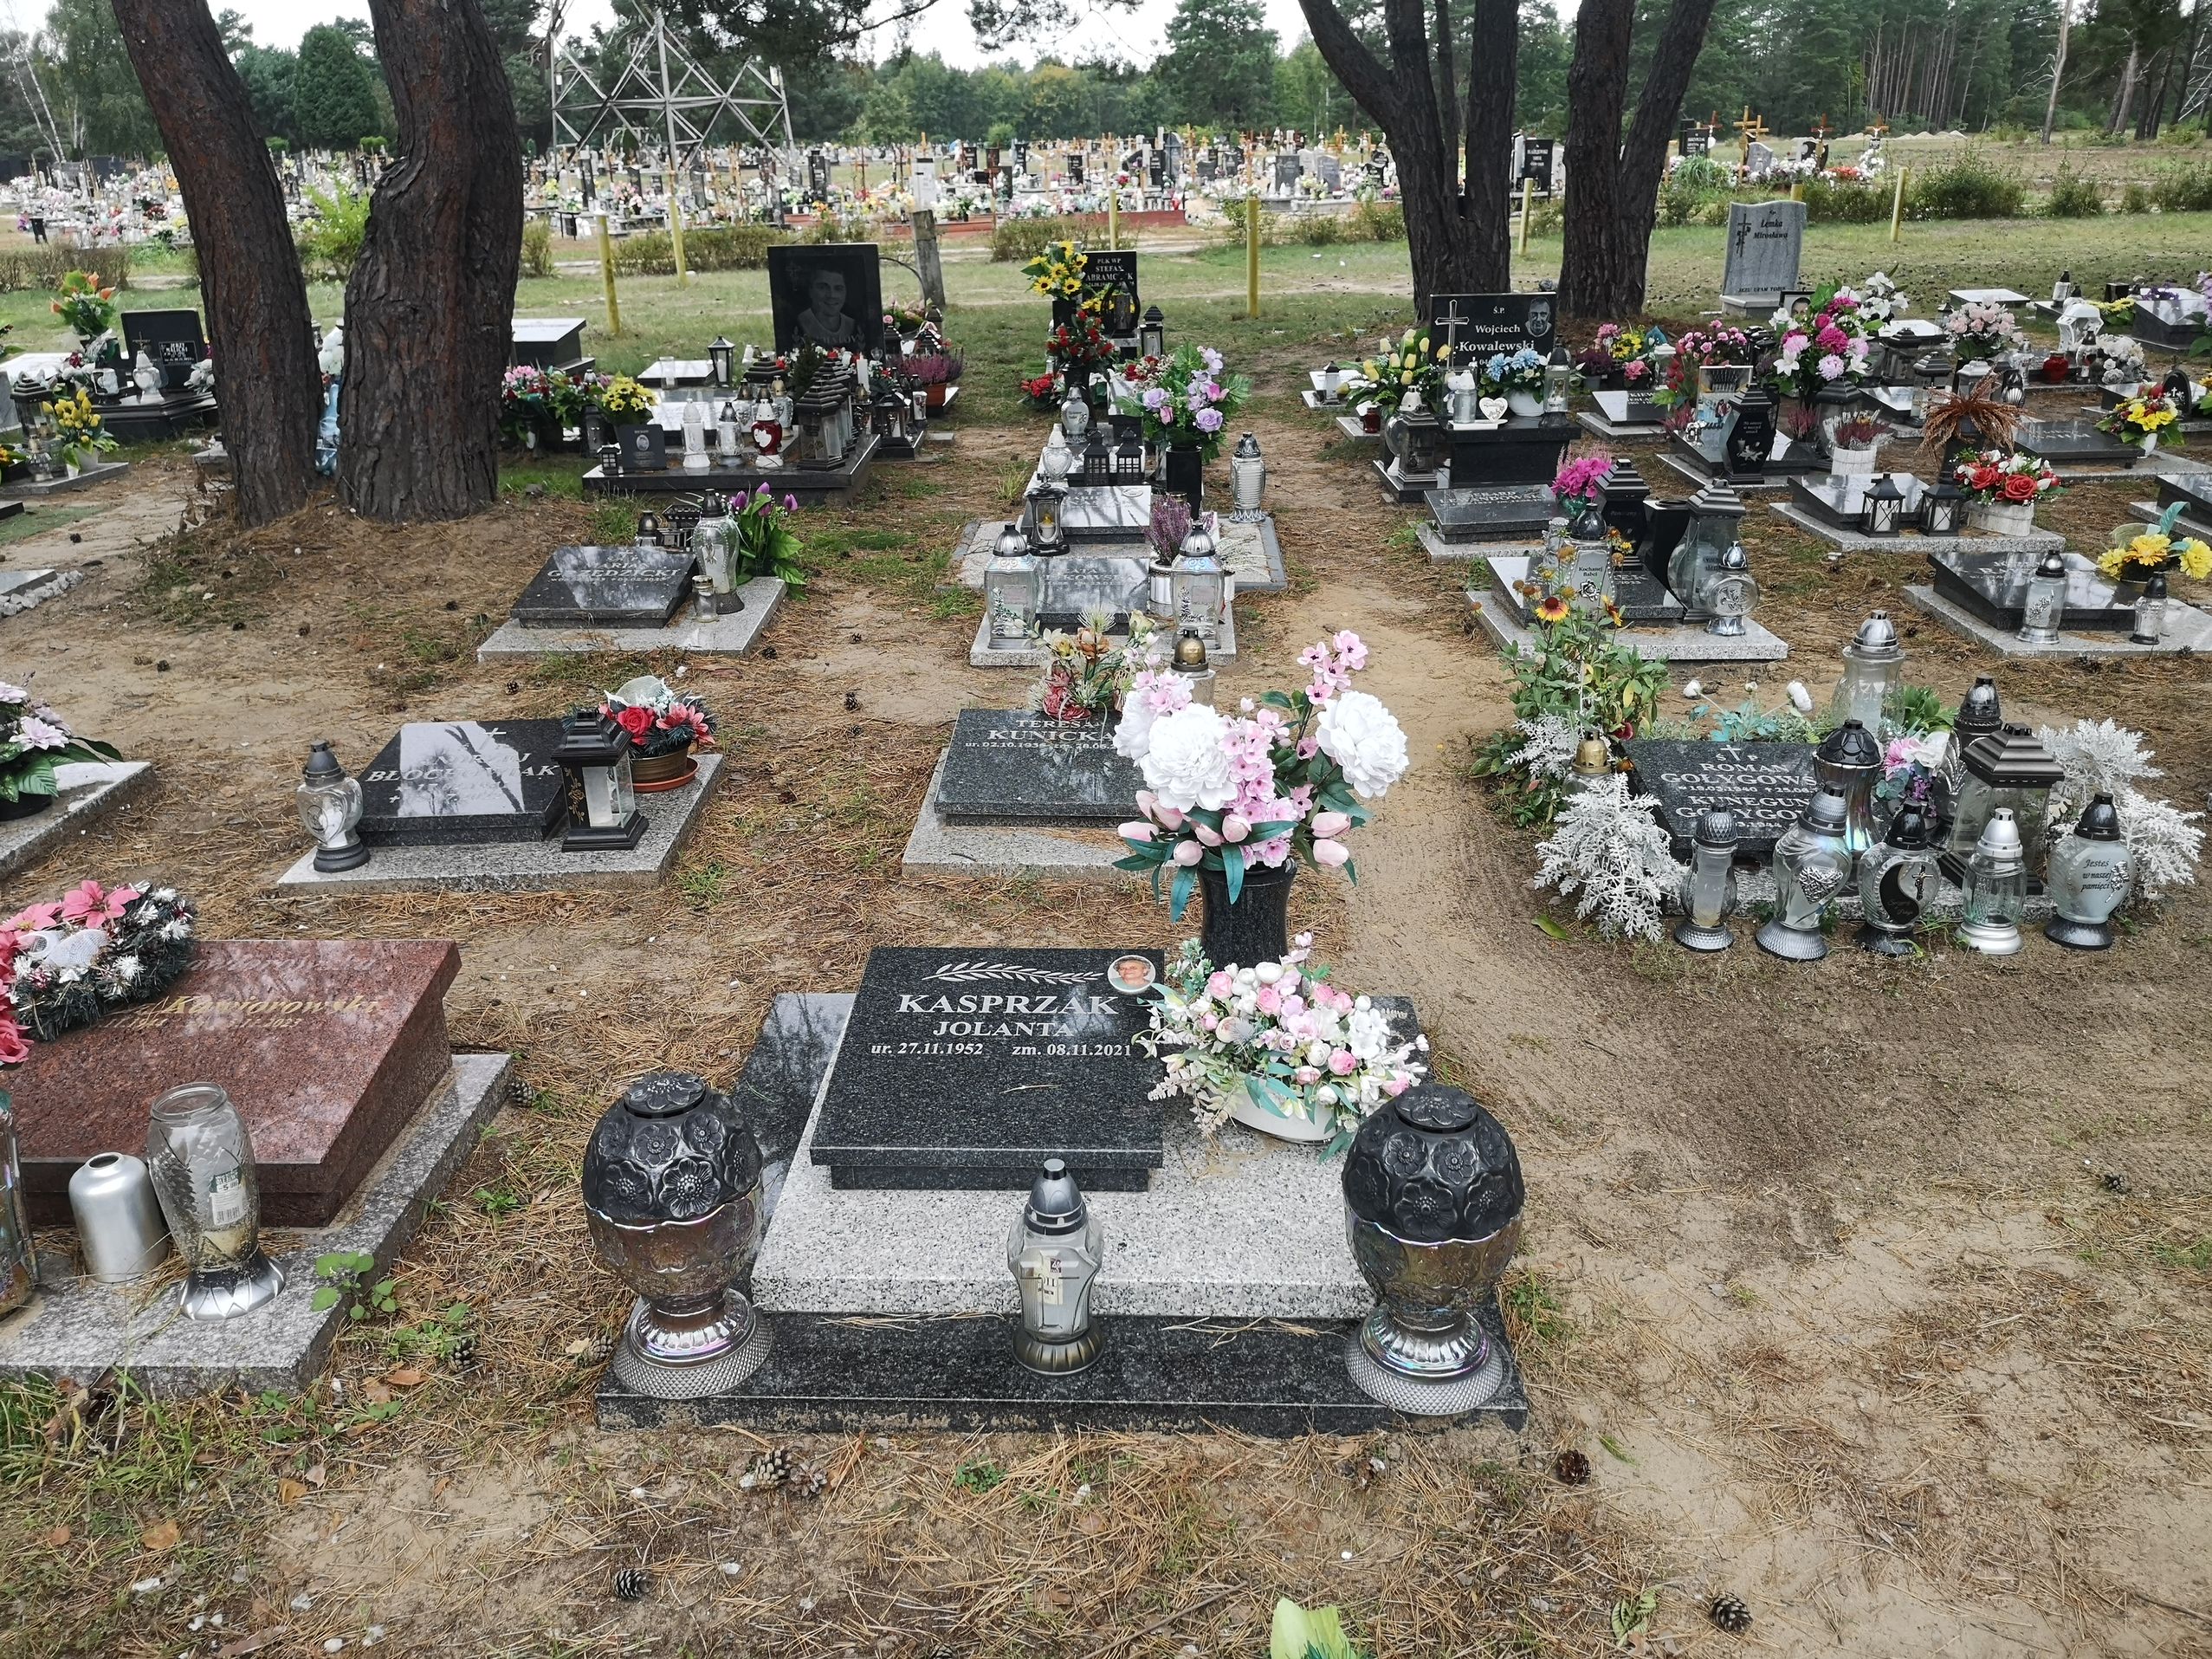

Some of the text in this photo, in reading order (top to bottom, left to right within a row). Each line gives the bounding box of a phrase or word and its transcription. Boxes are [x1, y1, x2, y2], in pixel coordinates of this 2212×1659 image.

[1085, 273, 1133, 282] ABRAMCK
[1475, 325, 1521, 335] Wojciech
[1459, 340, 1535, 352] Kowalewski
[1016, 720, 1096, 729] TERESA
[987, 729, 1115, 741] KUNICKA
[1699, 763, 1790, 773] ROMAN
[1660, 774, 1817, 786] GOŁYGOWS
[1688, 795, 1810, 807] KUNEGUN
[2083, 859, 2110, 869] Jesteś
[2091, 872, 2112, 882] naszej
[2080, 883, 2110, 893] pamięci
[896, 994, 1119, 1015] KASPRZAK
[932, 1021, 1075, 1037] JOLANTA
[870, 1042, 1131, 1057] ur. 27.11.1952 zm. 08.11.2021
